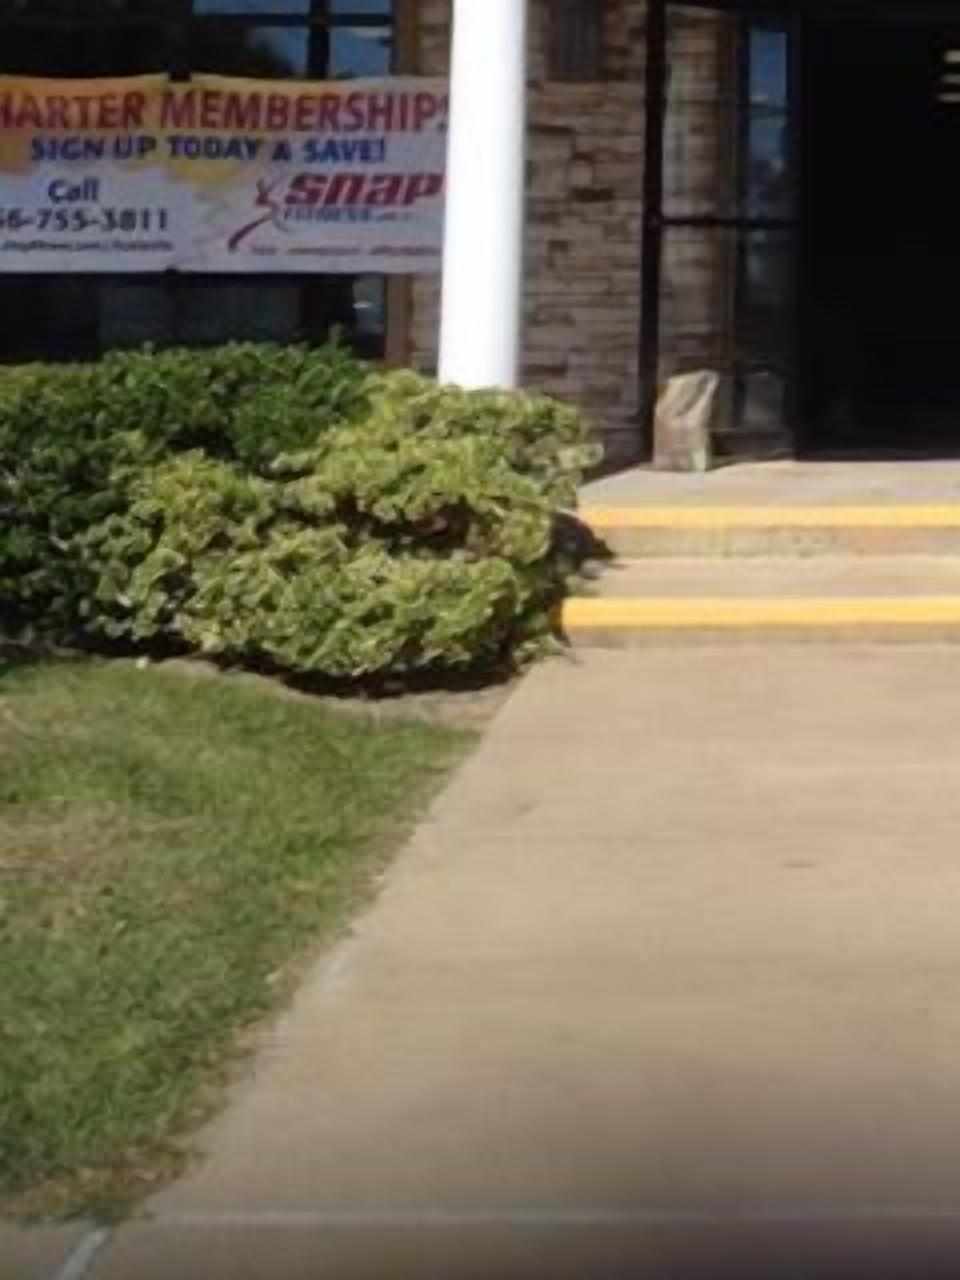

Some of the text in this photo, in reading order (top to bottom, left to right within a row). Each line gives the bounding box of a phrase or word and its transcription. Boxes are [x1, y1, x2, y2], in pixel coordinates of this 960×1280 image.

[31, 135, 105, 161] SIGN
[113, 134, 157, 160] UP
[167, 135, 264, 160] TODAY
[303, 137, 386, 163] SAVE!
[48, 176, 99, 204] Call
